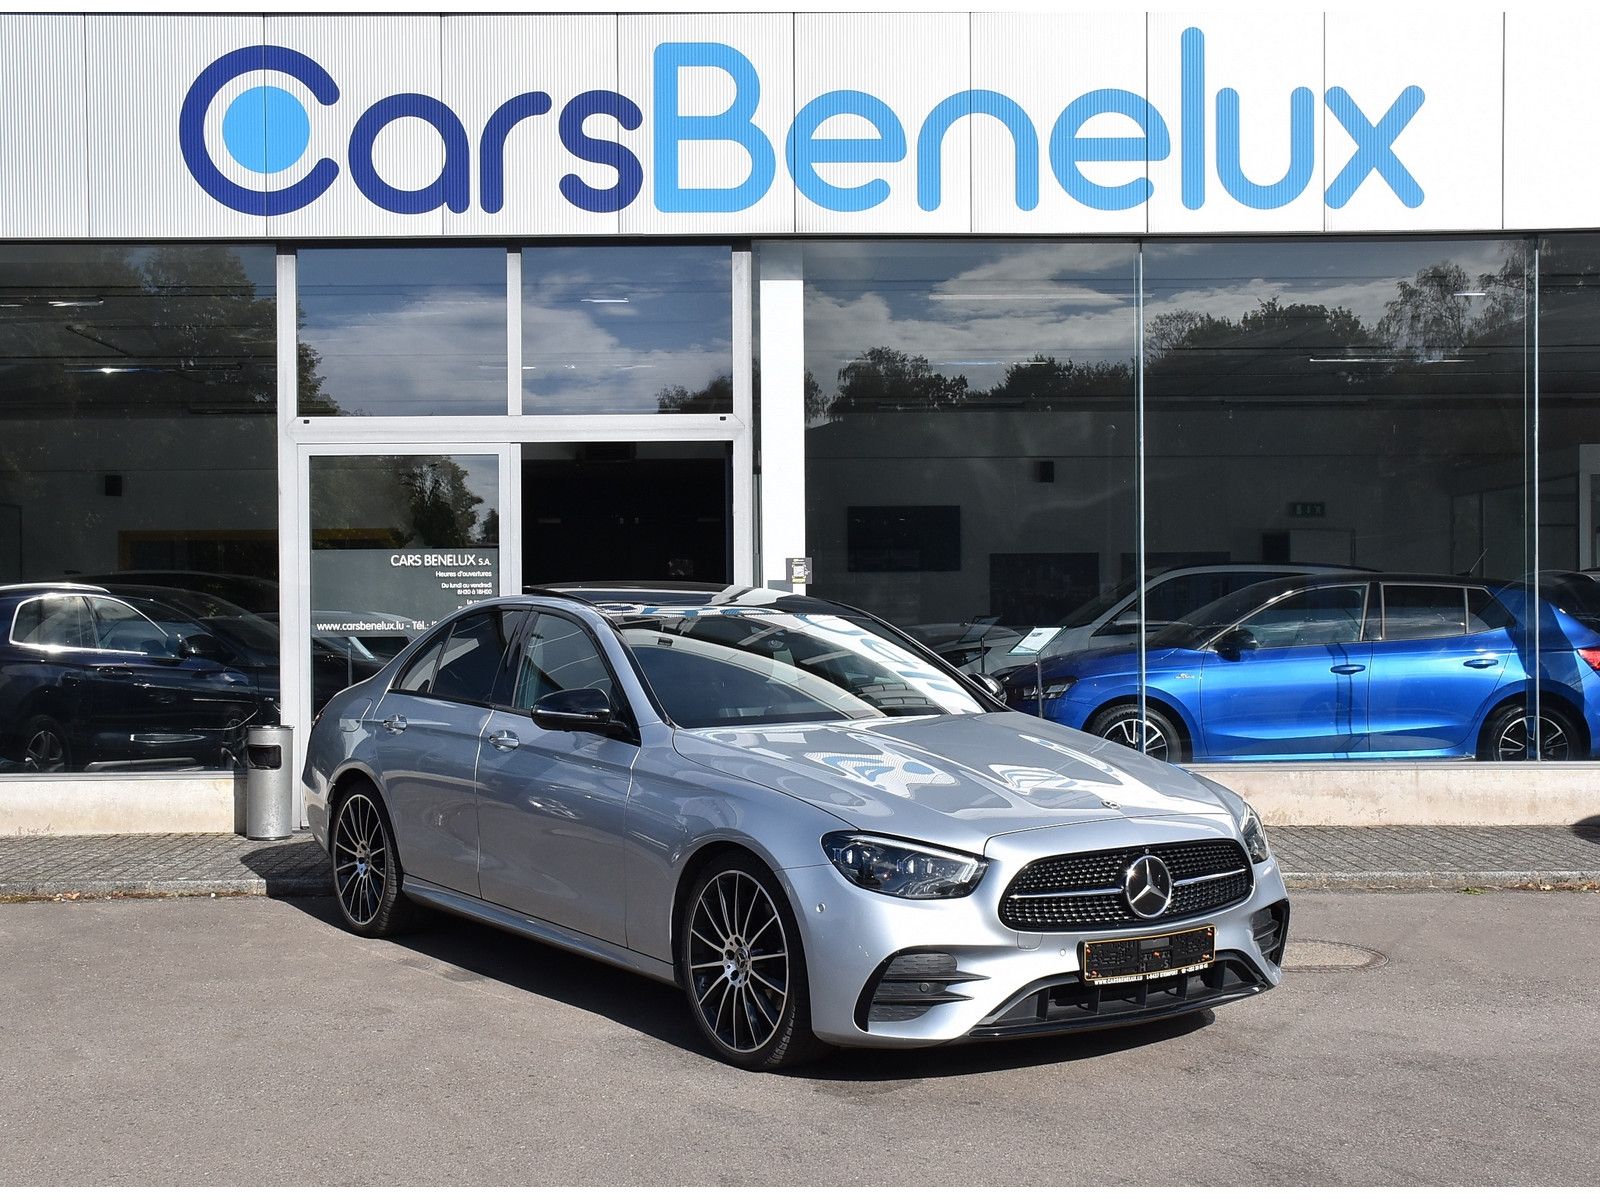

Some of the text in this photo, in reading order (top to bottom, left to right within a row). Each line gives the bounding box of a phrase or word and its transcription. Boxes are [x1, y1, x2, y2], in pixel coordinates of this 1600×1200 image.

[390, 554, 492, 567] CARS BENELUX S.A.
[316, 621, 405, 631] www.carsbenelux.lu
